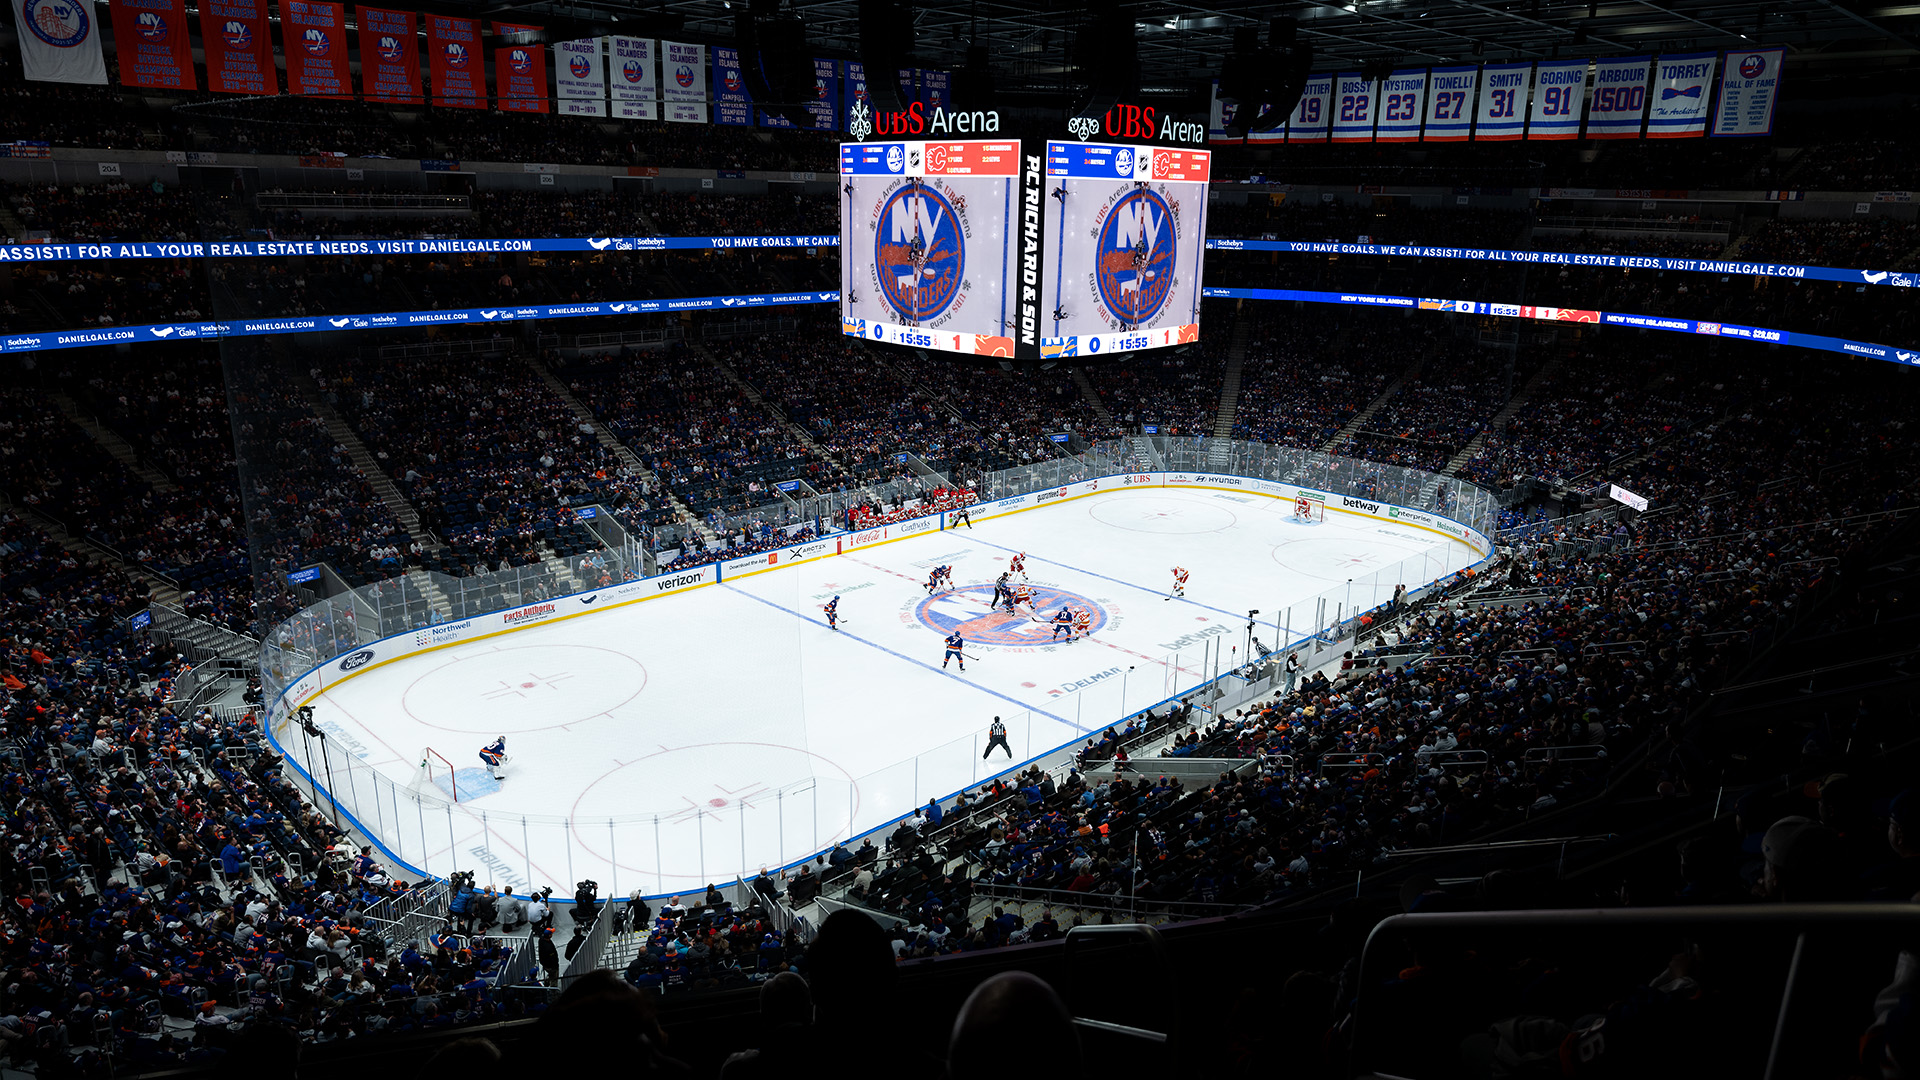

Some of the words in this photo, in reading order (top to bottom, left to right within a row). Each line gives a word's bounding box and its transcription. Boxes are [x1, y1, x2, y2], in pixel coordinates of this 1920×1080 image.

[122, 0, 173, 11] ISLANDERS
[209, 4, 258, 19] ISLANDERS
[289, 1, 308, 13] NEW
[310, 3, 333, 16] YORK
[290, 13, 335, 27] ISLANDERS
[366, 10, 384, 21] NEW
[386, 12, 407, 24] YORK
[367, 21, 408, 36] ISLANDERS
[435, 29, 474, 42] ISLANDERS
[137, 43, 172, 55] PATRICK
[616, 38, 630, 48] NEW
[631, 40, 647, 50] YORK
[137, 54, 175, 65] DIVISION
[224, 51, 256, 62] PATRICK
[616, 48, 648, 59] ISLANDERS
[669, 53, 699, 64] ISLANDERS
[133, 64, 181, 76] CHAMPIONS
[224, 60, 258, 72] DIVISION
[303, 57, 333, 68] PATRICK
[220, 70, 265, 82] CHAMPIONS
[1540, 69, 1583, 85] GORING
[1598, 67, 1646, 83] ARBOUR
[1661, 63, 1711, 80] TORREY
[299, 76, 340, 87] CHAMPIONS
[1341, 80, 1373, 94] BOSSY
[1383, 78, 1424, 92] NYSTROM
[1433, 75, 1474, 90] TONELLI
[1489, 73, 1523, 87] SMITH
[1724, 80, 1743, 89] HALL
[1744, 79, 1755, 88] OF
[1756, 78, 1776, 88] FAME
[1434, 91, 1466, 119] 27
[1489, 89, 1516, 118] 31
[1543, 86, 1572, 116] 91
[1591, 85, 1645, 113] 1500
[720, 107, 747, 116] CHAMPIONS
[1299, 97, 1321, 123] 19
[1340, 95, 1370, 122] 22
[1386, 93, 1416, 121] 23
[875, 101, 925, 136] UBS
[930, 105, 1000, 134] Arena
[1105, 103, 1156, 140] UBS
[1159, 114, 1204, 145] Arena
[102, 165, 117, 173] 204
[1026, 154, 1041, 186] P.C.
[871, 197, 884, 219] UBS
[882, 178, 902, 201] Arena
[1095, 203, 1110, 225] UBS
[1108, 182, 1130, 206] Arena
[711, 237, 731, 248] YOU
[734, 237, 759, 247] HAVE
[761, 237, 794, 247] GOALS.
[796, 237, 810, 246] WE
[812, 237, 830, 246] CAN
[1023, 187, 1039, 285] RICHARD
[0, 246, 72, 260] ASSIST!
[78, 245, 112, 258] FOR
[120, 245, 152, 257] ALL
[156, 244, 205, 258] YOUR
[210, 243, 253, 256] REAL
[257, 243, 315, 256] ESTATE
[320, 242, 374, 255] NEEDS,
[377, 242, 415, 253] VISIT
[419, 239, 532, 253] DANIELGALE.COM
[615, 241, 633, 251] Gale
[1290, 242, 1310, 252] YOU
[1313, 243, 1339, 253] HAVE
[1341, 244, 1378, 254] GOALS.
[1380, 246, 1396, 255] WE
[1399, 246, 1421, 256] CAN
[1423, 247, 1462, 258] ASSIST!
[1465, 249, 1485, 259] FOR
[1488, 250, 1507, 260] ALL
[1510, 251, 1540, 262] YOUR
[1542, 253, 1571, 264] REAL
[1574, 255, 1617, 267] ESTATE
[1619, 257, 1663, 270] NEEDS,
[1666, 259, 1697, 271] VISIT
[1699, 261, 1806, 278] DANIELGALE.COM
[869, 263, 881, 294] Arena
[1891, 276, 1912, 288] Gale
[884, 265, 952, 309] ISLANDERS
[1023, 285, 1037, 302] &
[1088, 272, 1101, 304] Arena
[1106, 266, 1167, 311] ISLANDERS
[877, 294, 890, 315] UBS
[951, 293, 967, 314] UBS
[1164, 289, 1176, 311] UBS
[1341, 295, 1357, 303] NEW
[1357, 296, 1376, 304] YORK
[1376, 297, 1414, 306] ISLANDERS
[409, 312, 469, 323] DANIELGALE.COM
[548, 305, 600, 315] DANIELGALE.COM
[1096, 304, 1110, 324] UBS
[1461, 302, 1470, 311] 0
[1492, 306, 1518, 316] 15:55
[1544, 309, 1550, 318] 1
[245, 320, 315, 333] DANIELGALE.COM
[930, 310, 953, 330] Arena
[1021, 303, 1036, 346] SON
[1147, 308, 1166, 330] Arena
[1606, 314, 1625, 324] NEW
[1625, 316, 1646, 326] YORK
[1646, 318, 1689, 330] ISLANDERS
[57, 330, 136, 345] DANIELGALE.COM
[873, 323, 884, 339] 0
[1163, 330, 1170, 345] 1
[7, 336, 41, 348] Sotheby's
[899, 332, 932, 347] 15:55
[952, 334, 961, 351] 1
[1089, 336, 1101, 353] 0
[1118, 337, 1148, 350] 15:55
[1843, 342, 1887, 357] DANIELGALE.COM
[1133, 474, 1151, 484] UBS
[1208, 476, 1243, 486] HYUNDAI
[969, 507, 987, 518] SHOP
[1342, 496, 1380, 515] betway
[1436, 521, 1463, 536] Heineken
[855, 529, 881, 545] Coca-Cola
[728, 560, 750, 571] Download
[657, 573, 702, 591] verizon
[503, 611, 523, 622] Parts
[523, 603, 556, 617] Authority
[432, 621, 472, 636] Northwell
[432, 632, 458, 644] Health
[1157, 623, 1233, 652] betway
[345, 652, 368, 670] Ford
[1060, 666, 1124, 694] DELMAR
[469, 845, 529, 889] HYUNDAI
